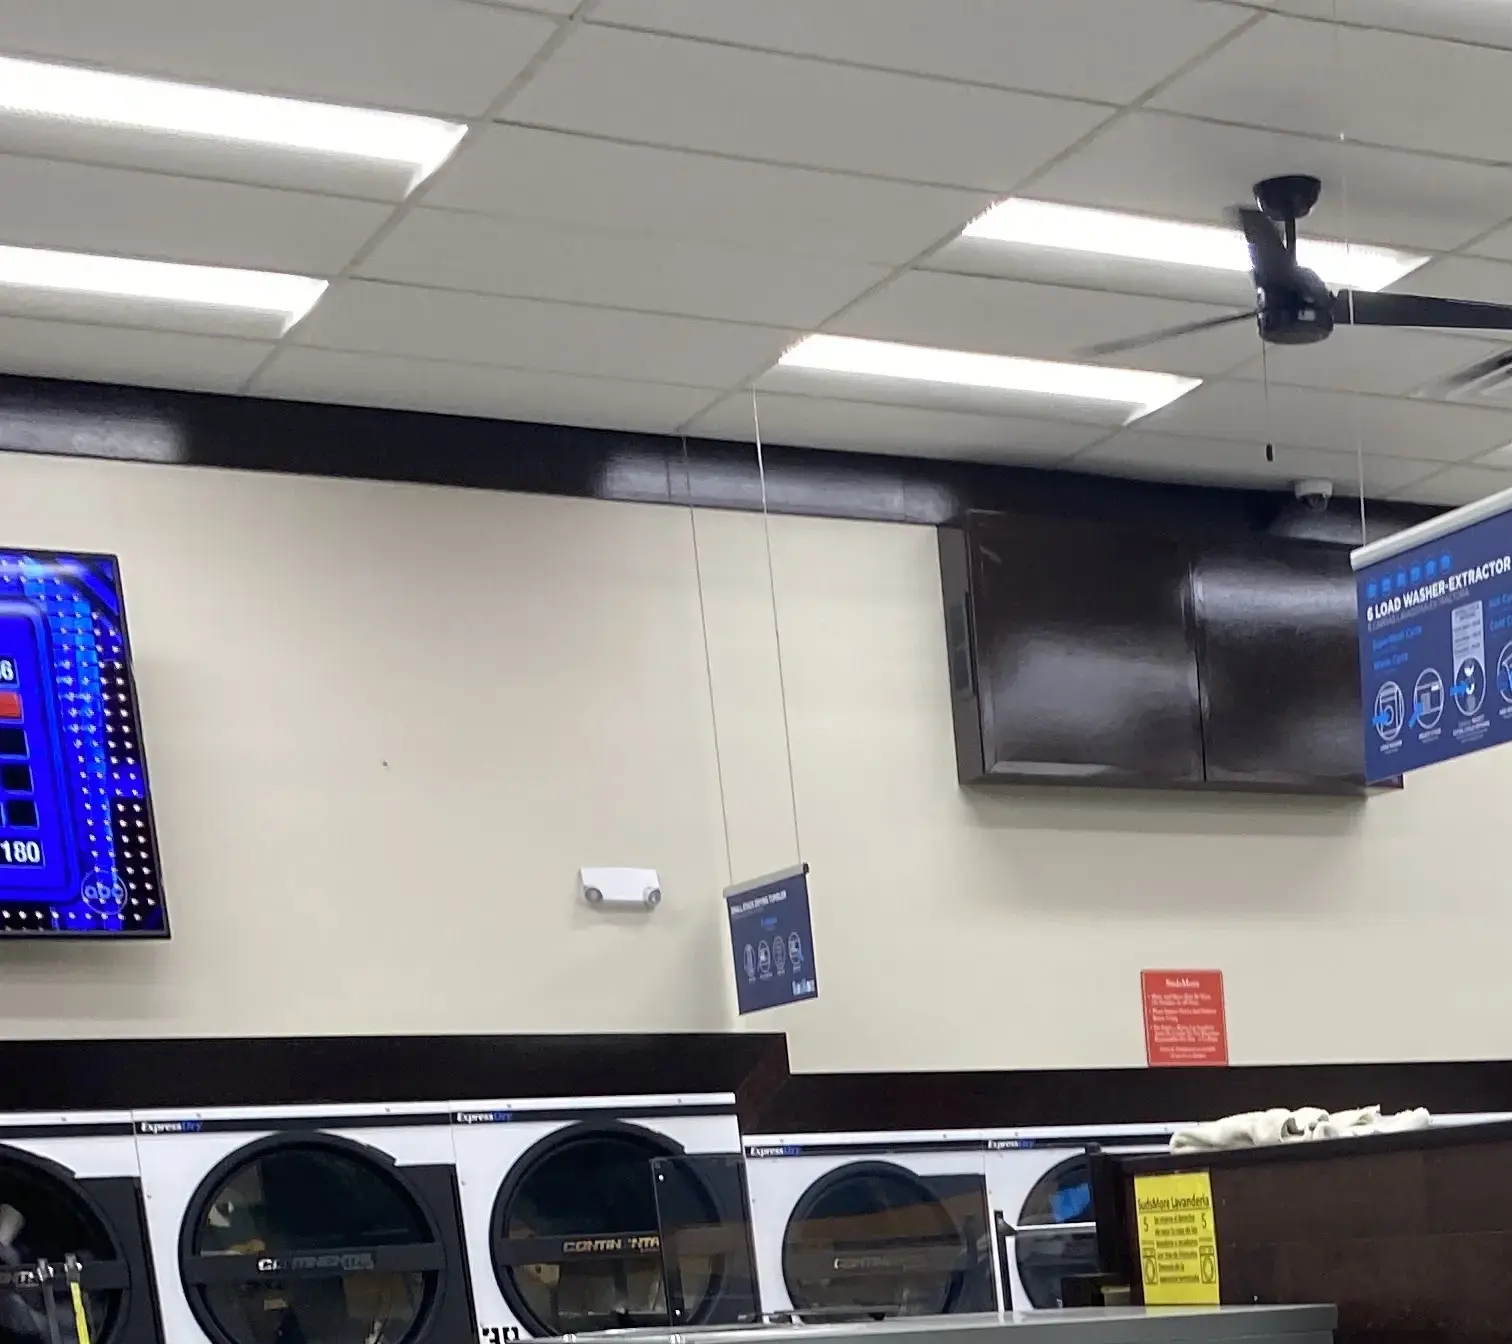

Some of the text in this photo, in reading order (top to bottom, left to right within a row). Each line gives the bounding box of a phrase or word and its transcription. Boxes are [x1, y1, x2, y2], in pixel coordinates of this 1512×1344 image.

[1367, 556, 1512, 622] 6 LOAD WASHER-EXTRACTOR
